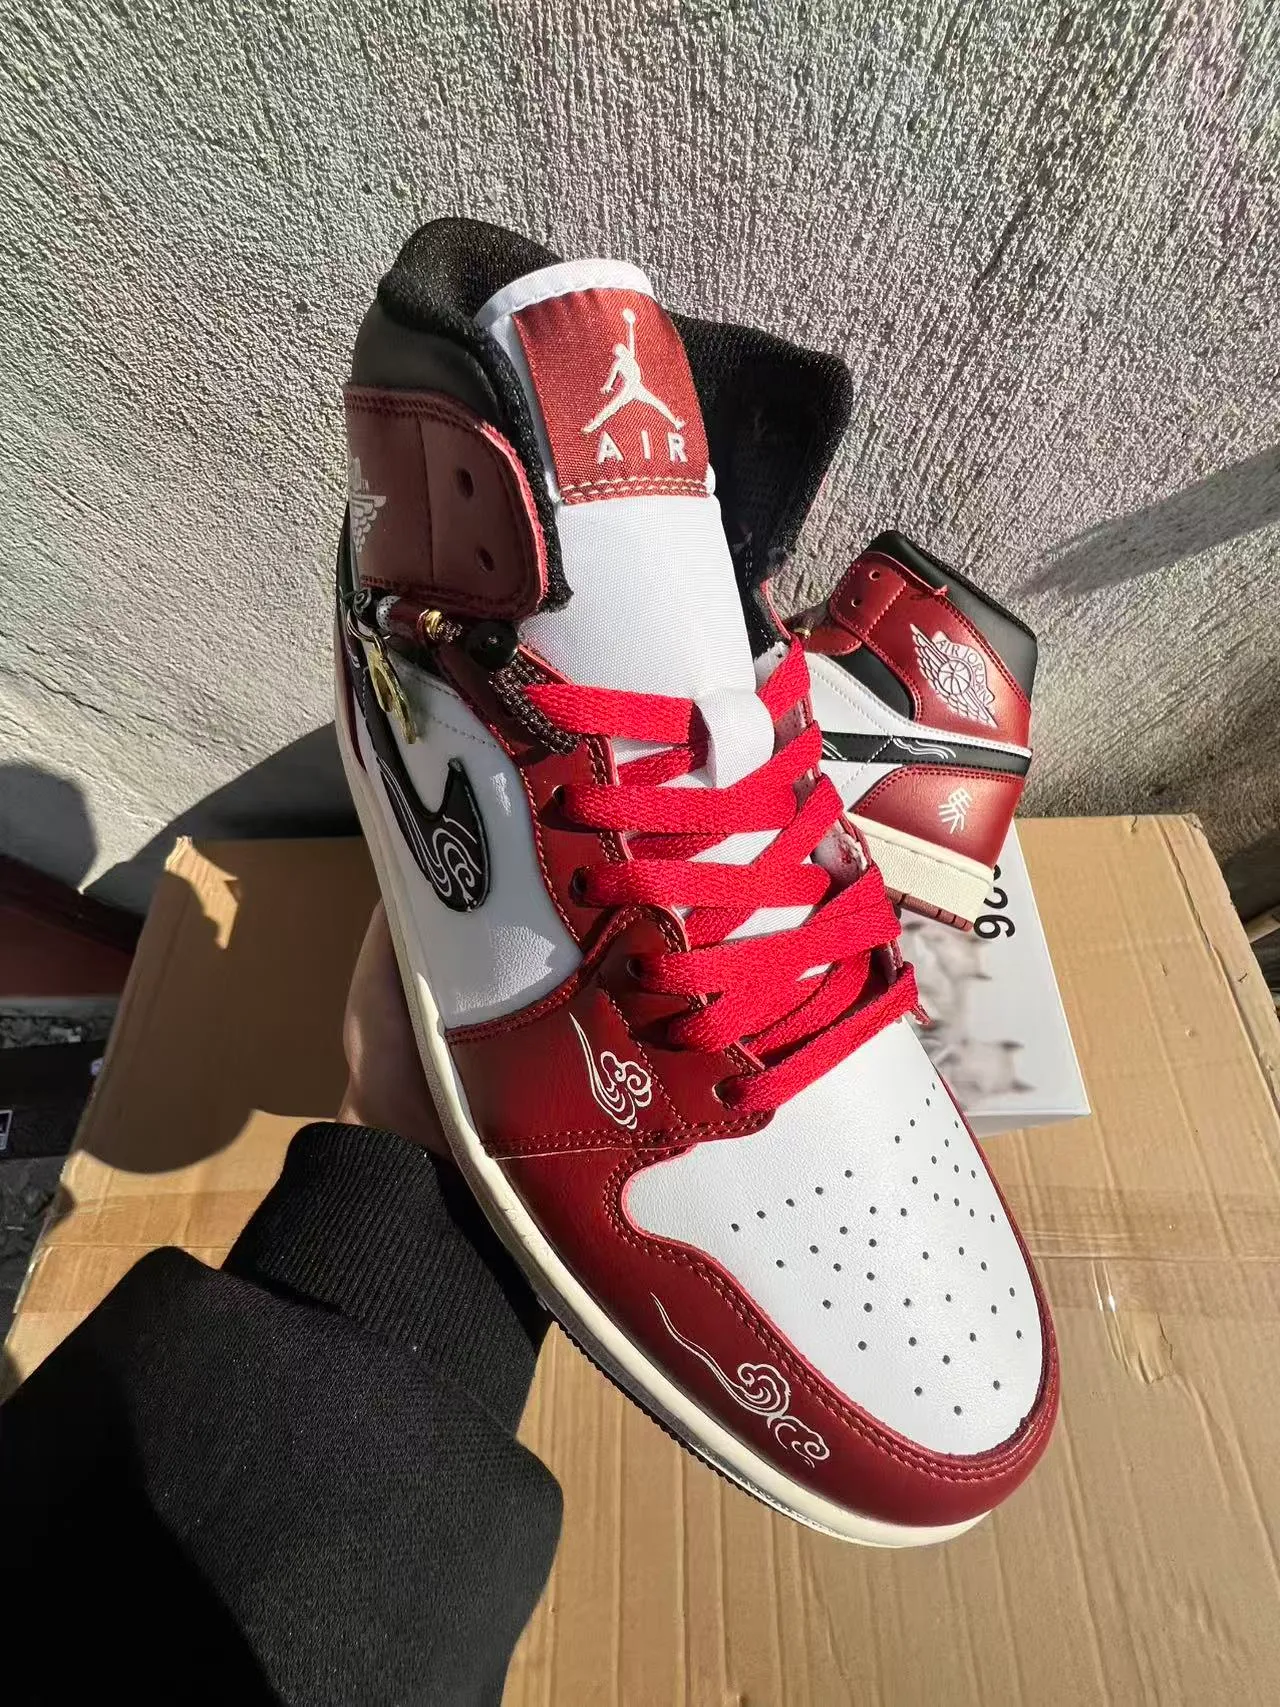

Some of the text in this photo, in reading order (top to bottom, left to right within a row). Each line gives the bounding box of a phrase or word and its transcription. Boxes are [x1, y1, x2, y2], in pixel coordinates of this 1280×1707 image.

[597, 430, 688, 464] AIR
[936, 639, 991, 703] AIR JORDAN
